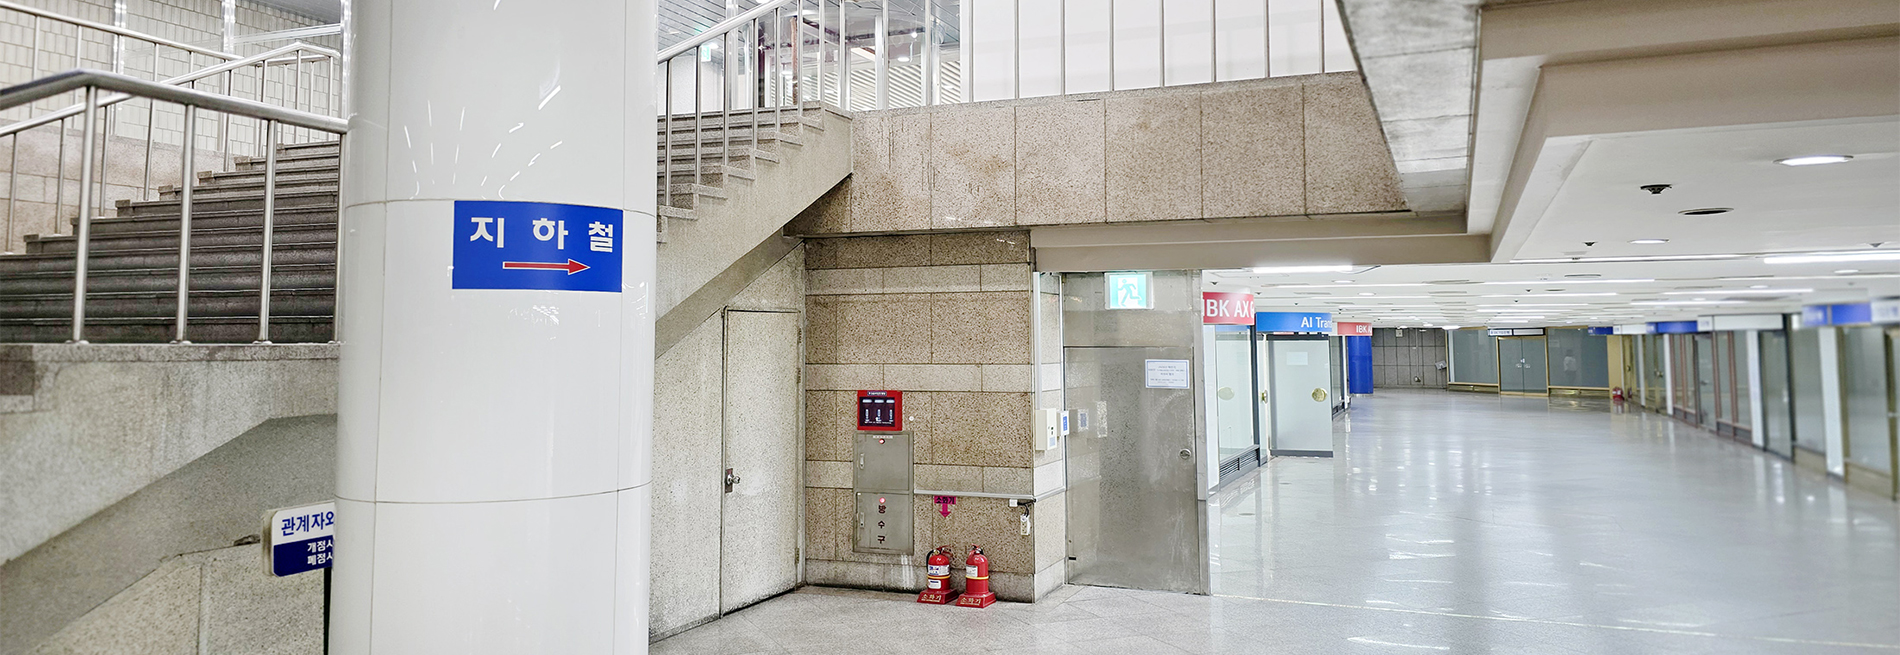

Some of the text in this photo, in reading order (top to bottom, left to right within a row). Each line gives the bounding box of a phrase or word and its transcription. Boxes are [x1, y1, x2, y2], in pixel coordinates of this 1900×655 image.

[470, 217, 614, 253] 지하철
[1300, 316, 1312, 328] AI
[1355, 324, 1367, 334] IBK
[936, 496, 955, 504] 소화기
